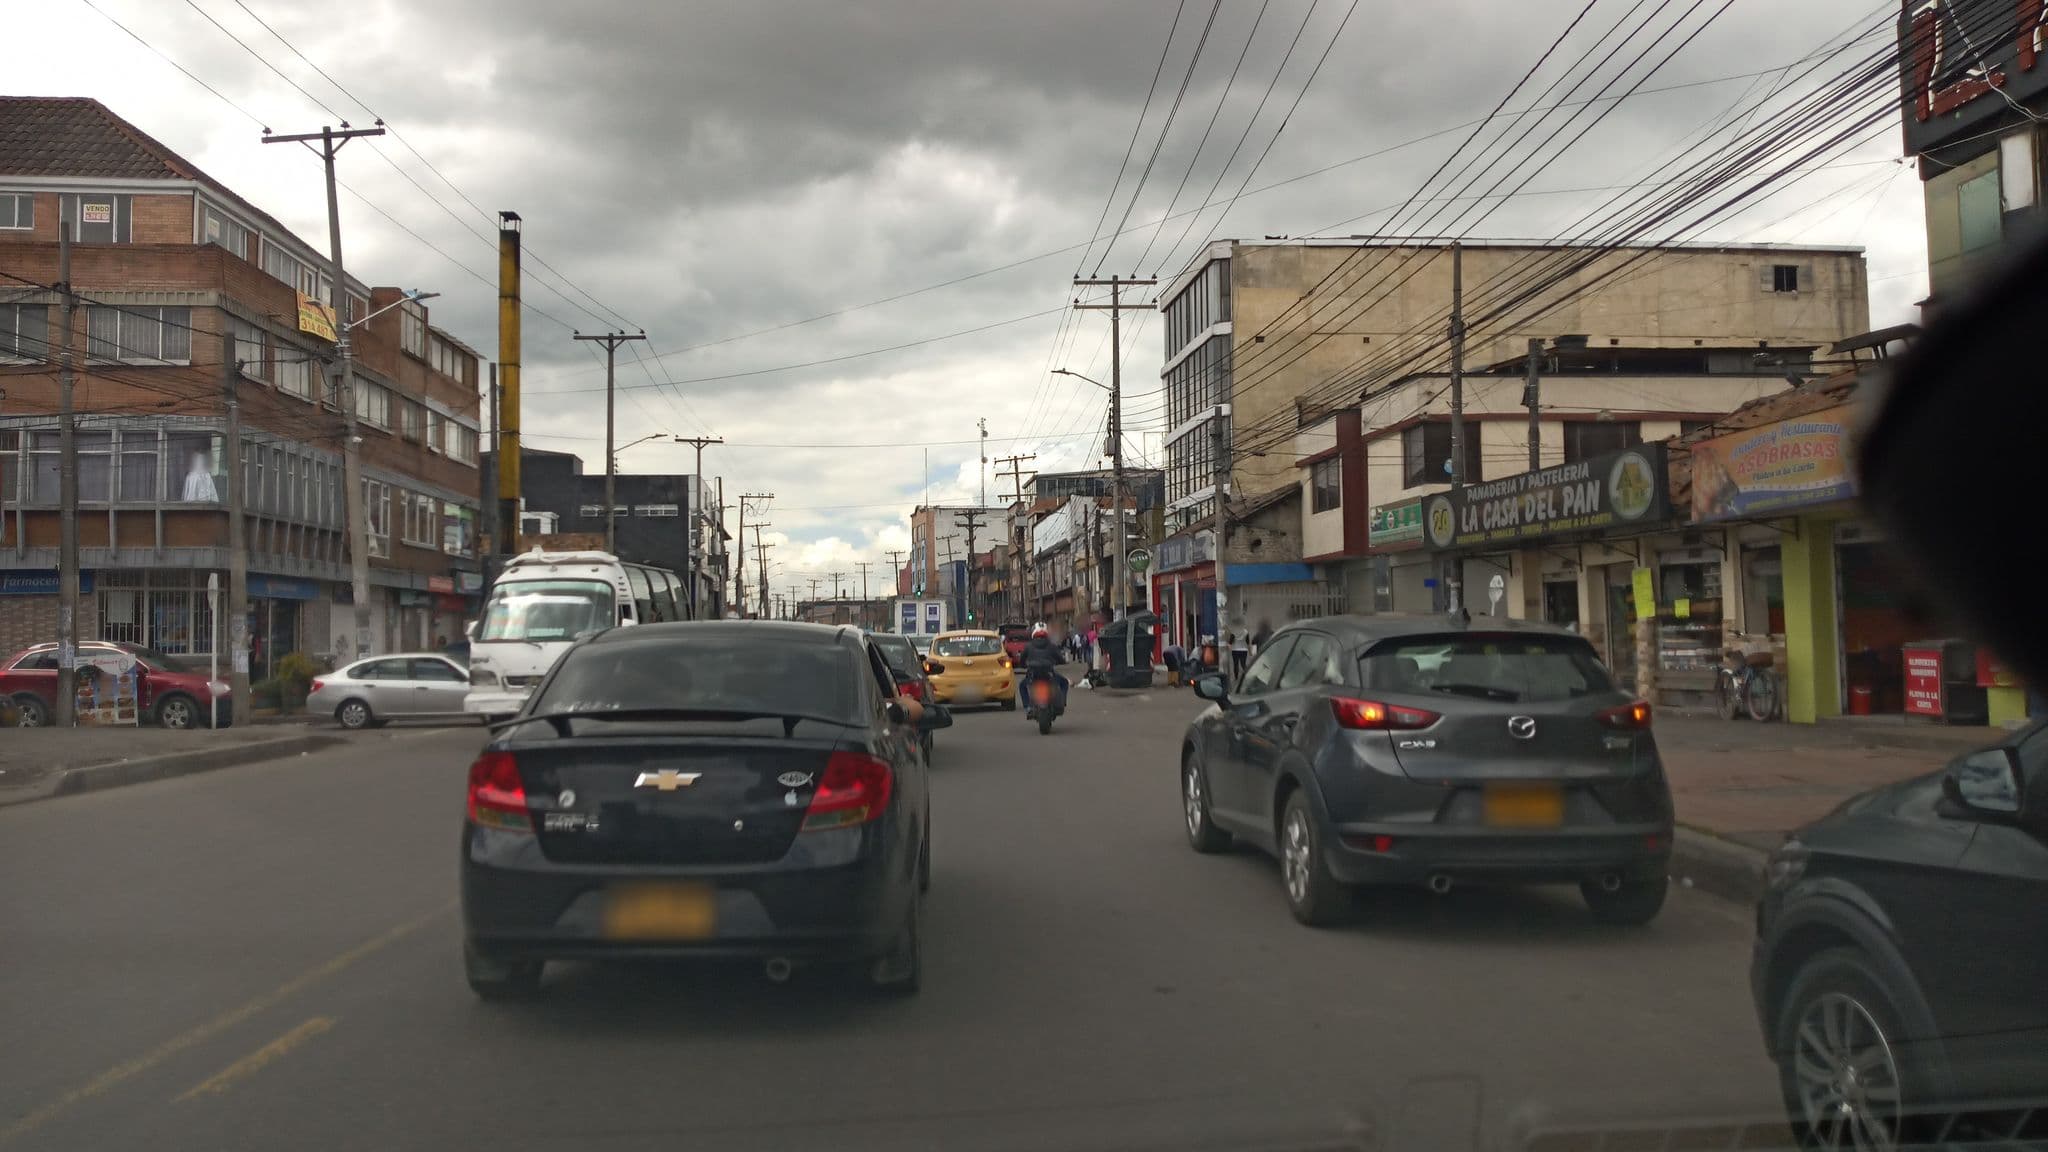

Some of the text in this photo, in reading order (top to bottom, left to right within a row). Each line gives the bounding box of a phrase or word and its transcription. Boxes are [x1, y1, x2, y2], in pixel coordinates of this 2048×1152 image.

[1467, 462, 1590, 502] PANADERIA Y PASTELERIA
[1461, 480, 1600, 532] LA CASA DEL PAN
[3, 575, 62, 591] farmacen
